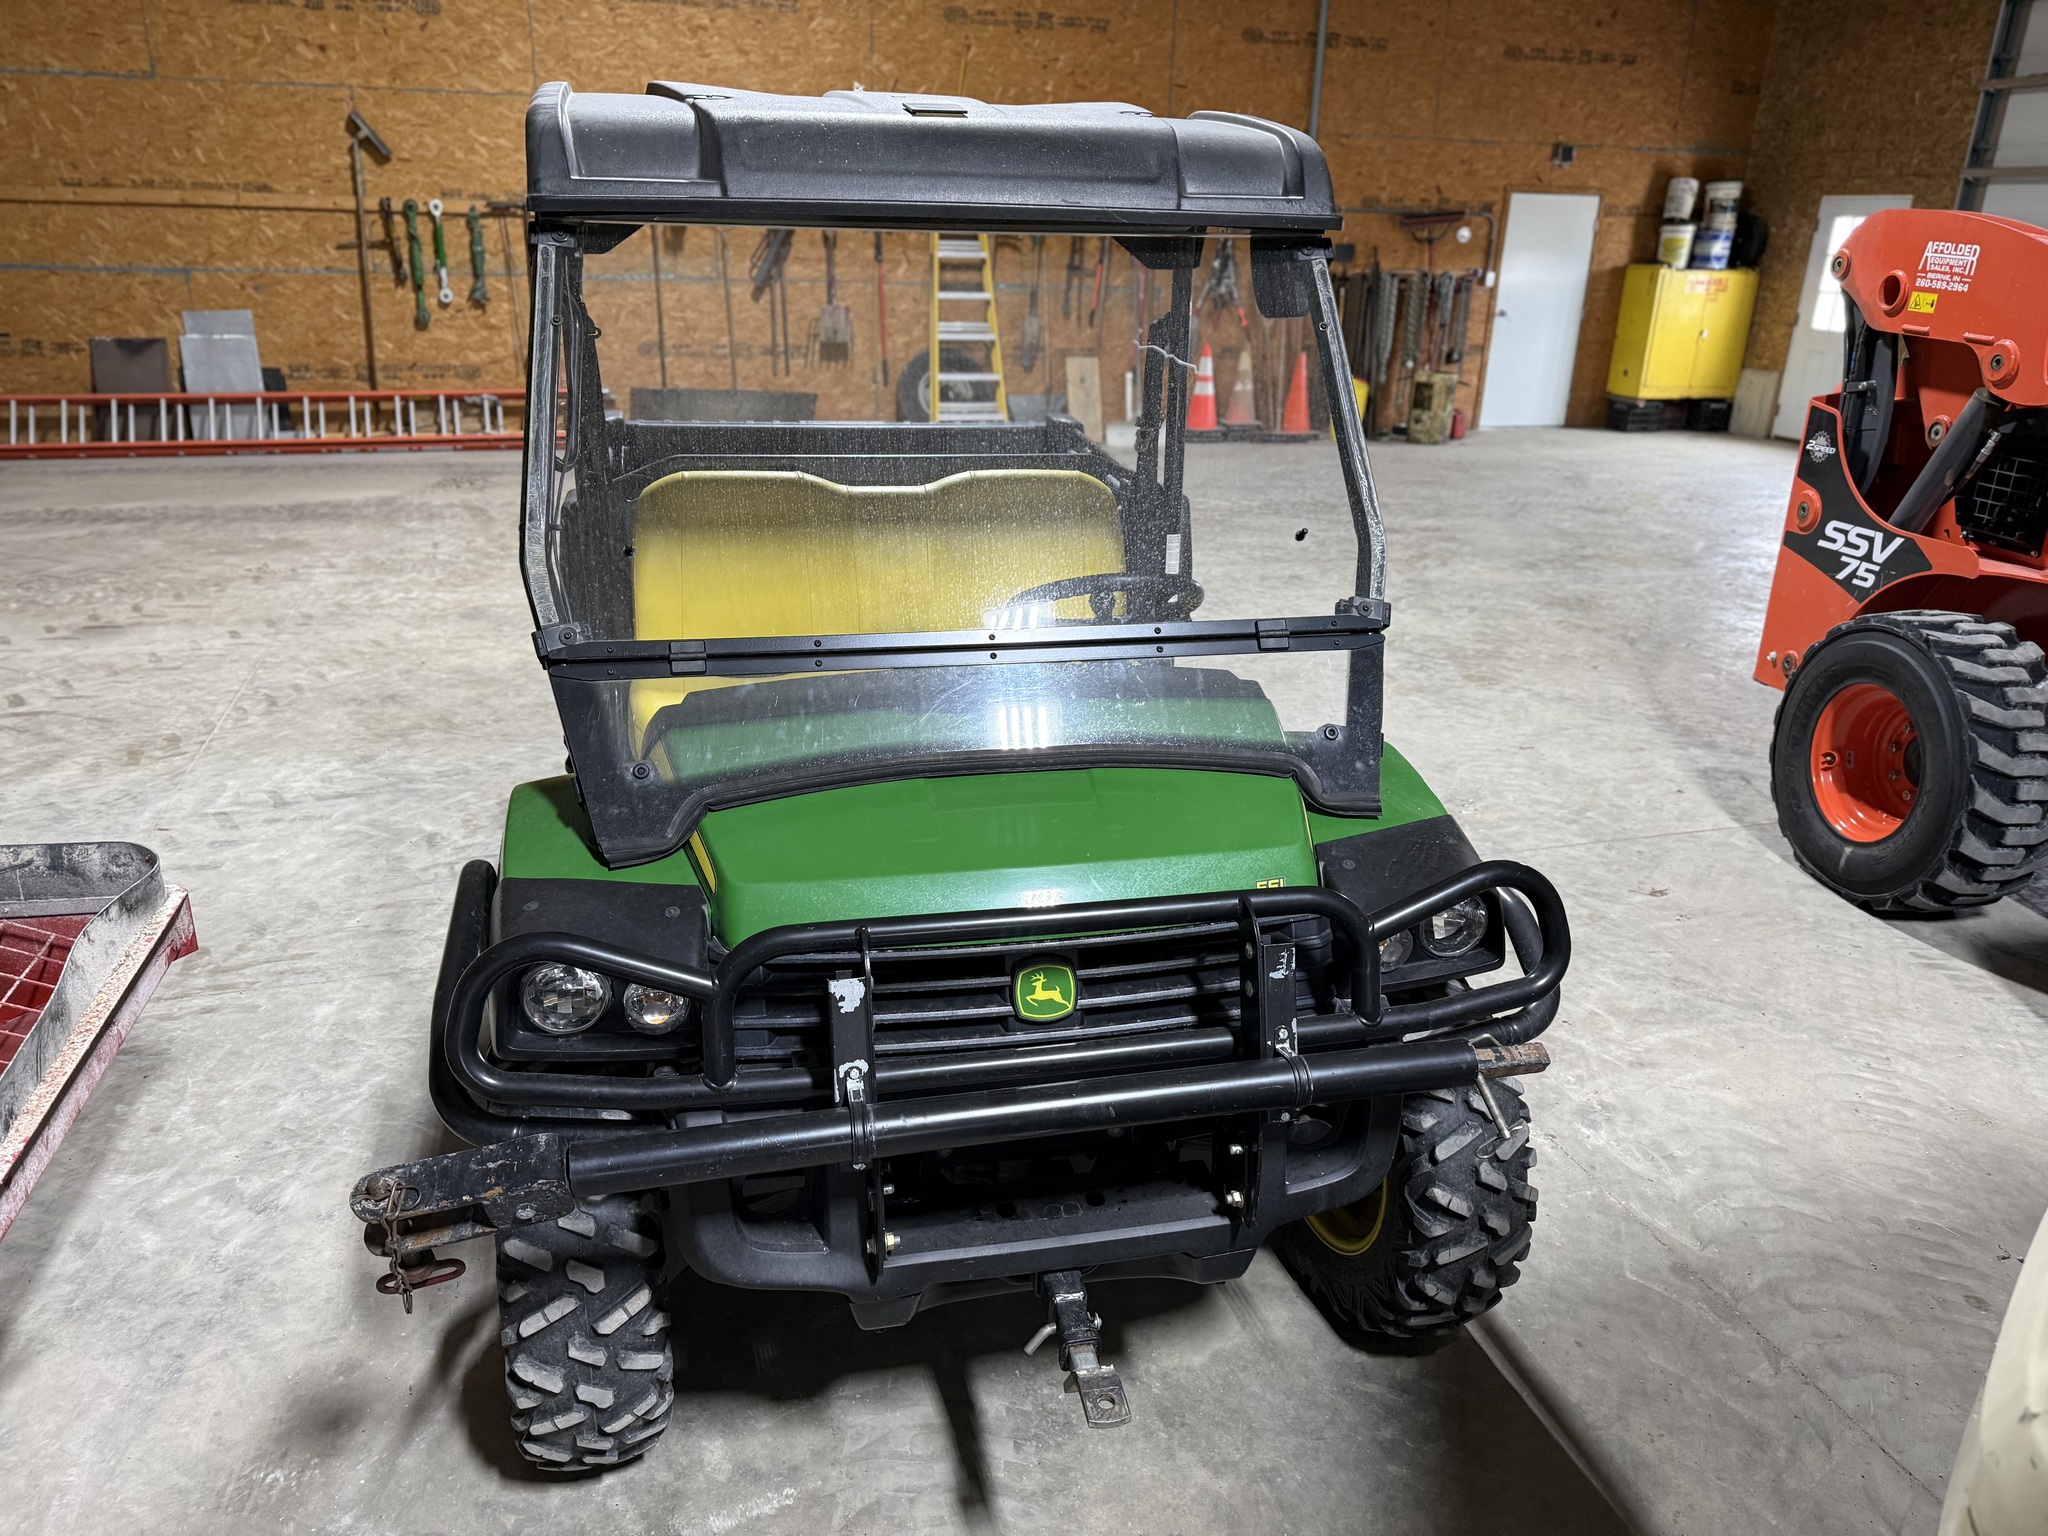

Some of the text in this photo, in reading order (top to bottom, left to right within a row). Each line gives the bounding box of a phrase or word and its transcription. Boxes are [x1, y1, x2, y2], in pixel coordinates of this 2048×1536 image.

[1918, 241, 1981, 276] AFFOLDER
[1930, 257, 1968, 267] EQUIPMENT
[1930, 264, 1951, 273] SALES,
[1927, 273, 1951, 282] BERNE,
[1915, 278, 1969, 292] 260-589-2964
[1817, 520, 1905, 564] SSV
[1835, 555, 1881, 588] 75
